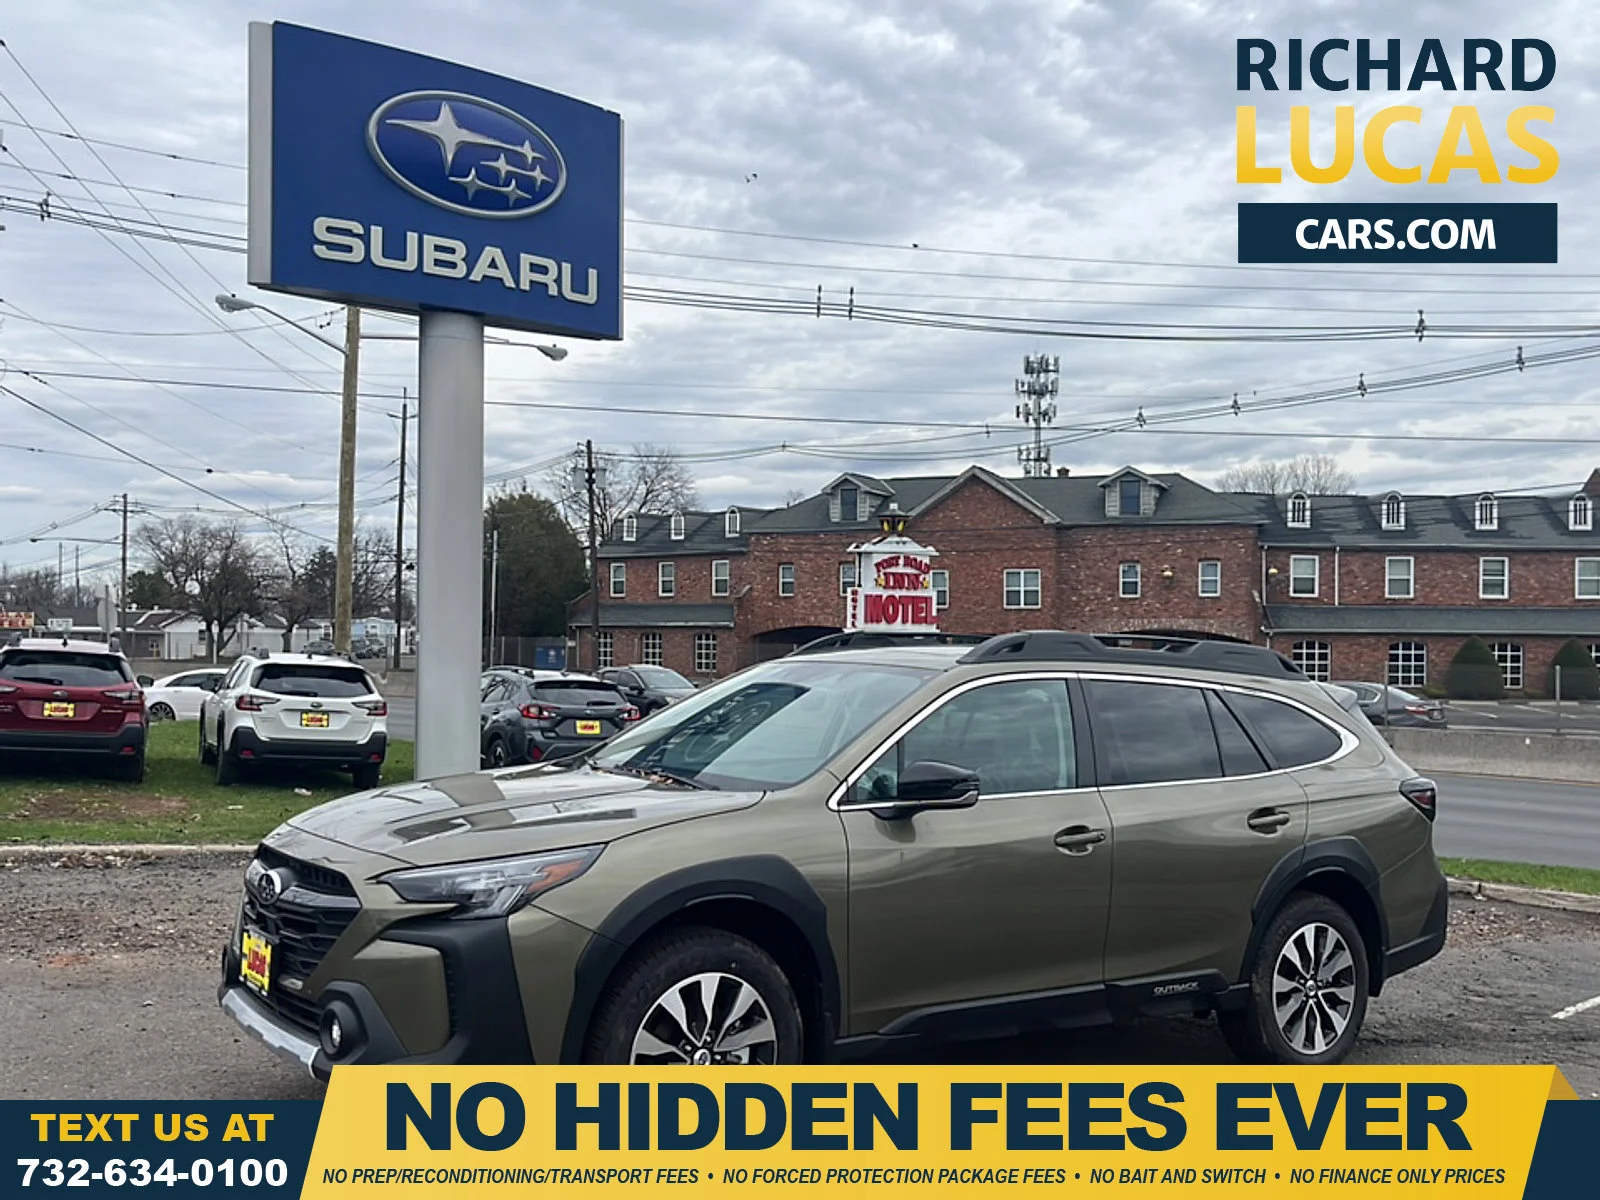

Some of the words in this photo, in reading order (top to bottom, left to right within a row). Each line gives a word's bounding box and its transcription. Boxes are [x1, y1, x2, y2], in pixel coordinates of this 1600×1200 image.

[312, 215, 599, 306] SUBARU
[882, 571, 922, 591] INN
[863, 593, 941, 625] MOTEL
